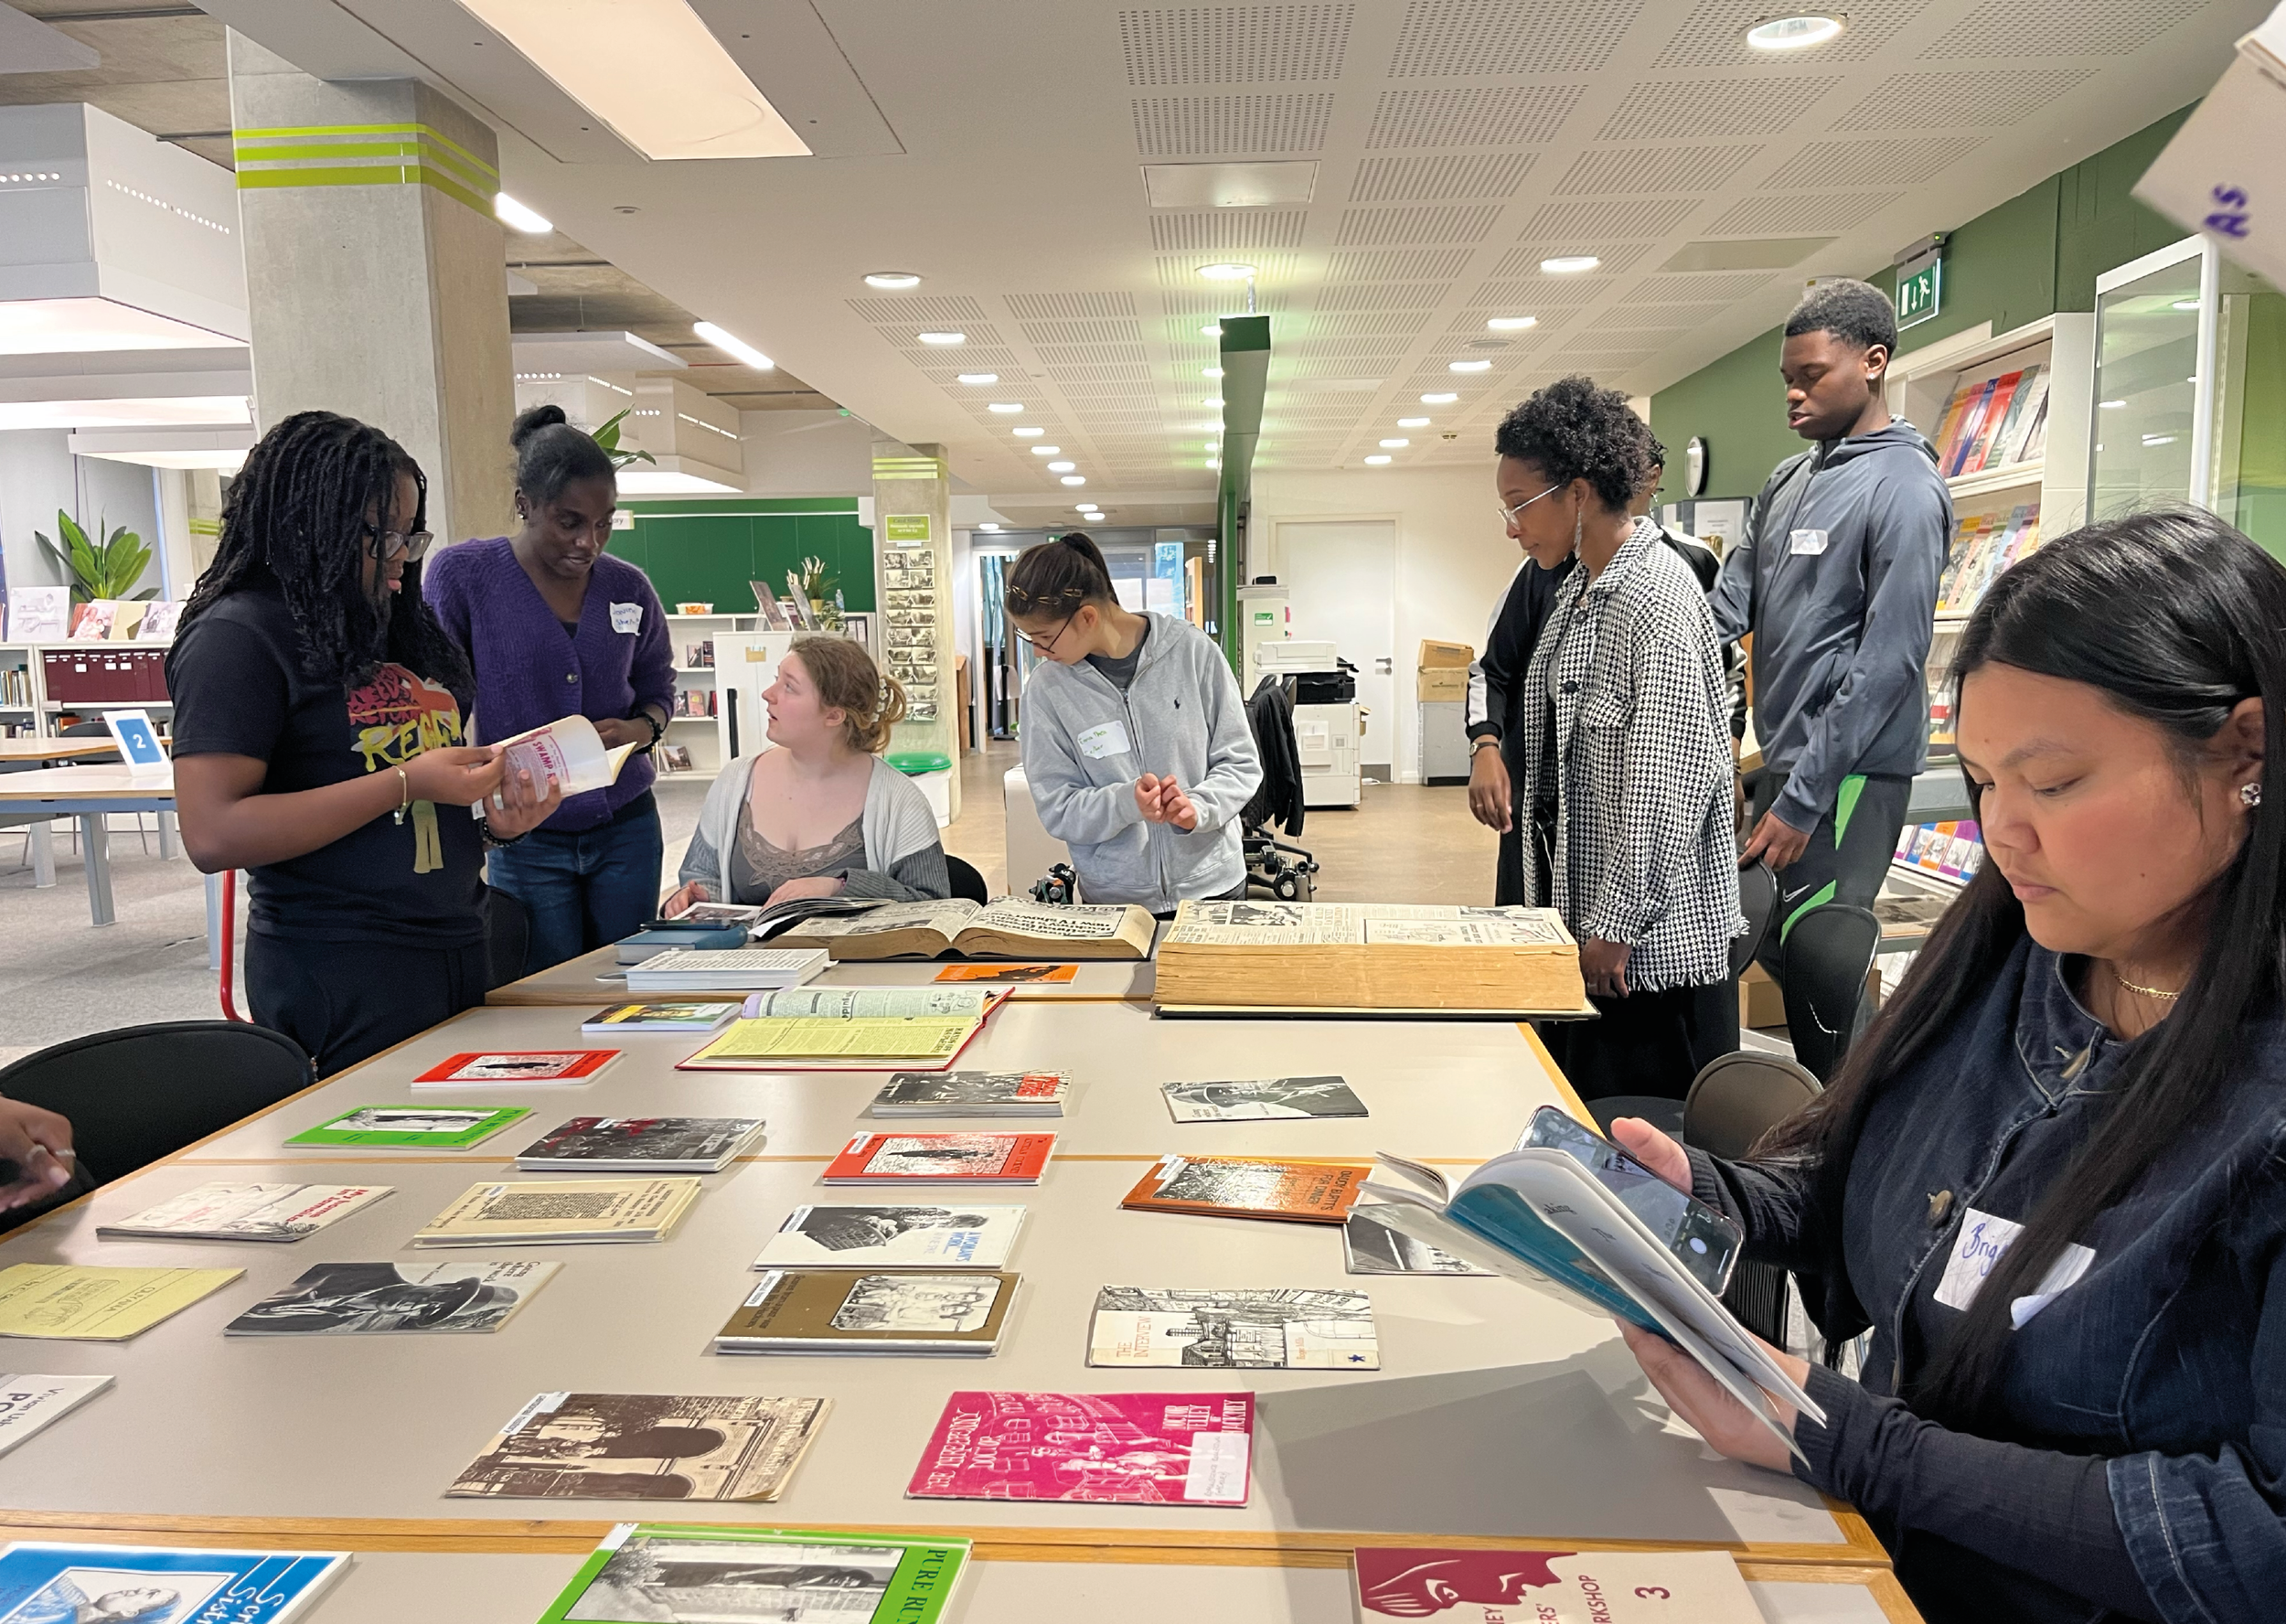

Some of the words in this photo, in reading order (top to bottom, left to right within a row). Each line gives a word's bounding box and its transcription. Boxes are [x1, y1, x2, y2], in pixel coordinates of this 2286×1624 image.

[134, 734, 146, 748] 2
[1317, 1174, 1334, 1184] FOR
[1331, 1170, 1353, 1188] DADDY
[336, 1189, 371, 1200] My
[1305, 1185, 1327, 1204] DINNER
[281, 1196, 344, 1222] Jamaica
[304, 1200, 352, 1218] home
[954, 1236, 980, 1261] WOMAN'S
[480, 1269, 507, 1282] work
[501, 1262, 529, 1277] where
[510, 1262, 542, 1277] Going
[1132, 1315, 1153, 1357] INTERVIEW
[1116, 1341, 1133, 1357] THE
[18, 1387, 66, 1412] Vivian
[518, 1394, 550, 1416] personal
[499, 1416, 529, 1434] history
[1161, 1405, 1190, 1429] DOCTOR
[929, 1406, 988, 1468] THREEPENNY
[967, 1435, 1006, 1469] DOCTOR
[924, 1469, 957, 1489] THE
[911, 1549, 948, 1591] PURE
[1635, 1587, 1670, 1600] 3
